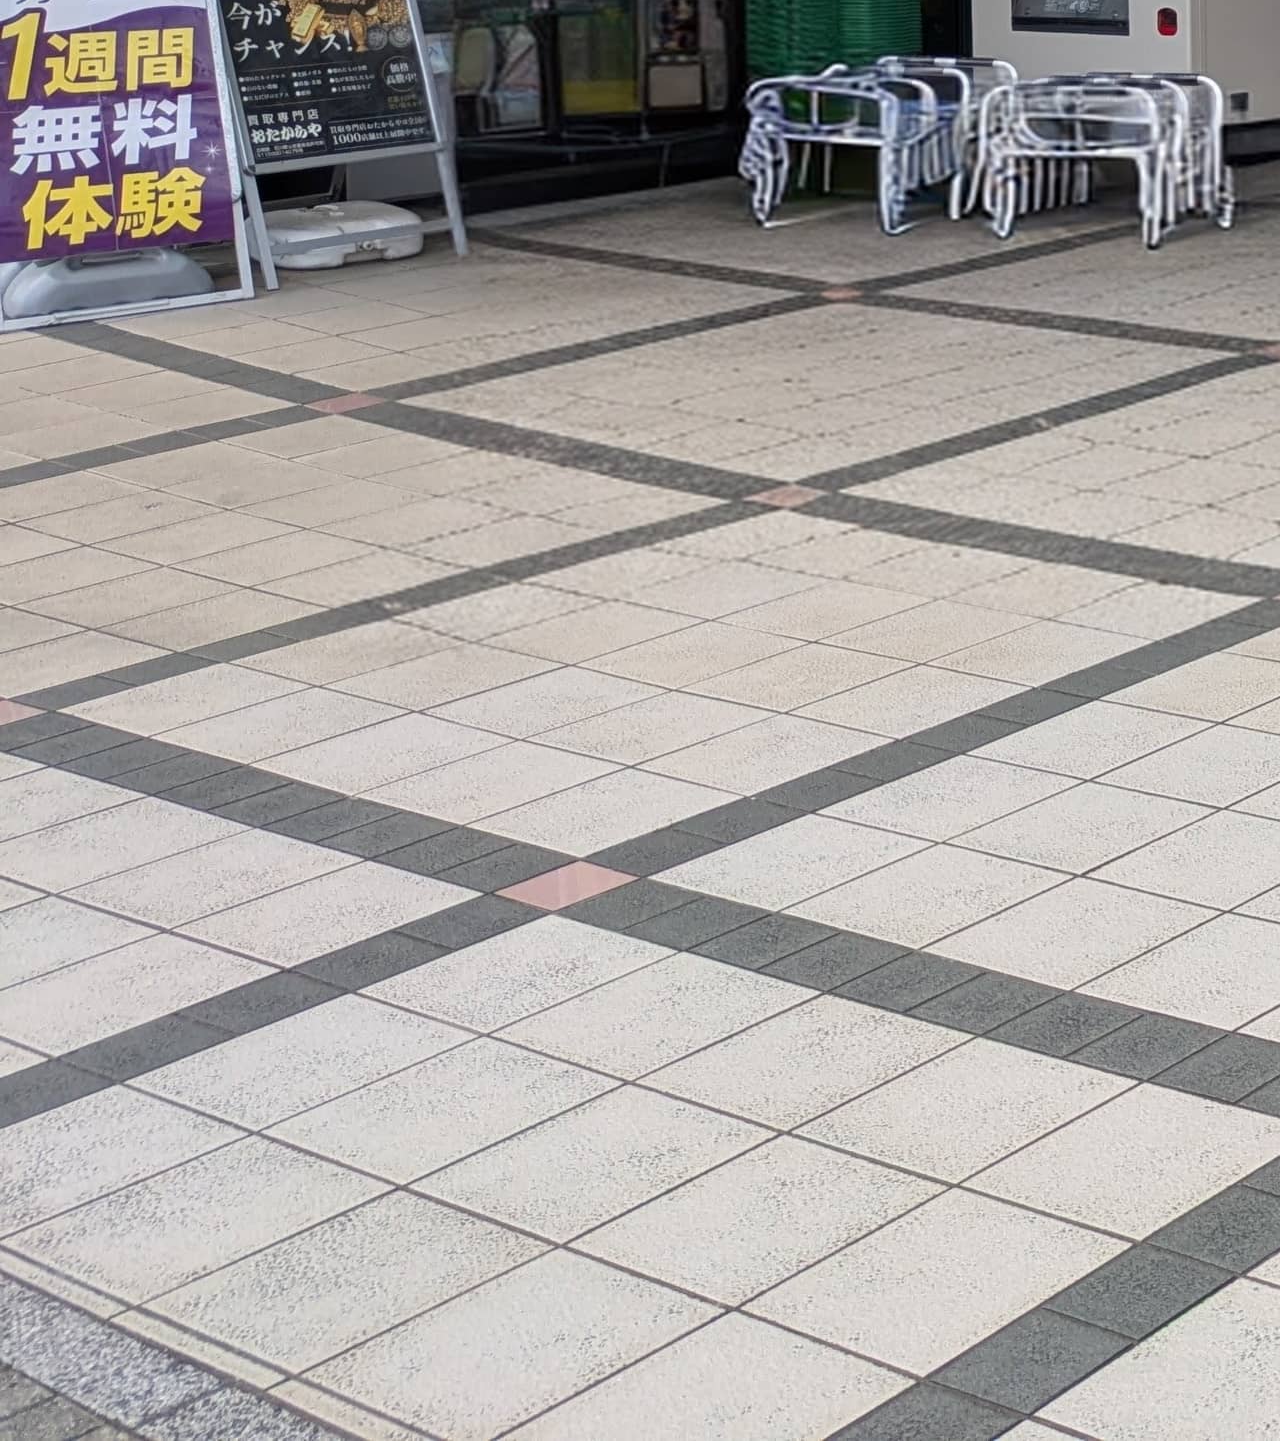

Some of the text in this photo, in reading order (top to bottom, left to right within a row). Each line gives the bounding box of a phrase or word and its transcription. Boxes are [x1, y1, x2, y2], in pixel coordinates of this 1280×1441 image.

[227, 1, 282, 30] 今が
[1, 12, 195, 101] 1週間
[9, 94, 198, 175] 無料
[247, 109, 320, 127] 買取専門店
[250, 122, 323, 144] おたからや
[22, 166, 207, 251] 体験
